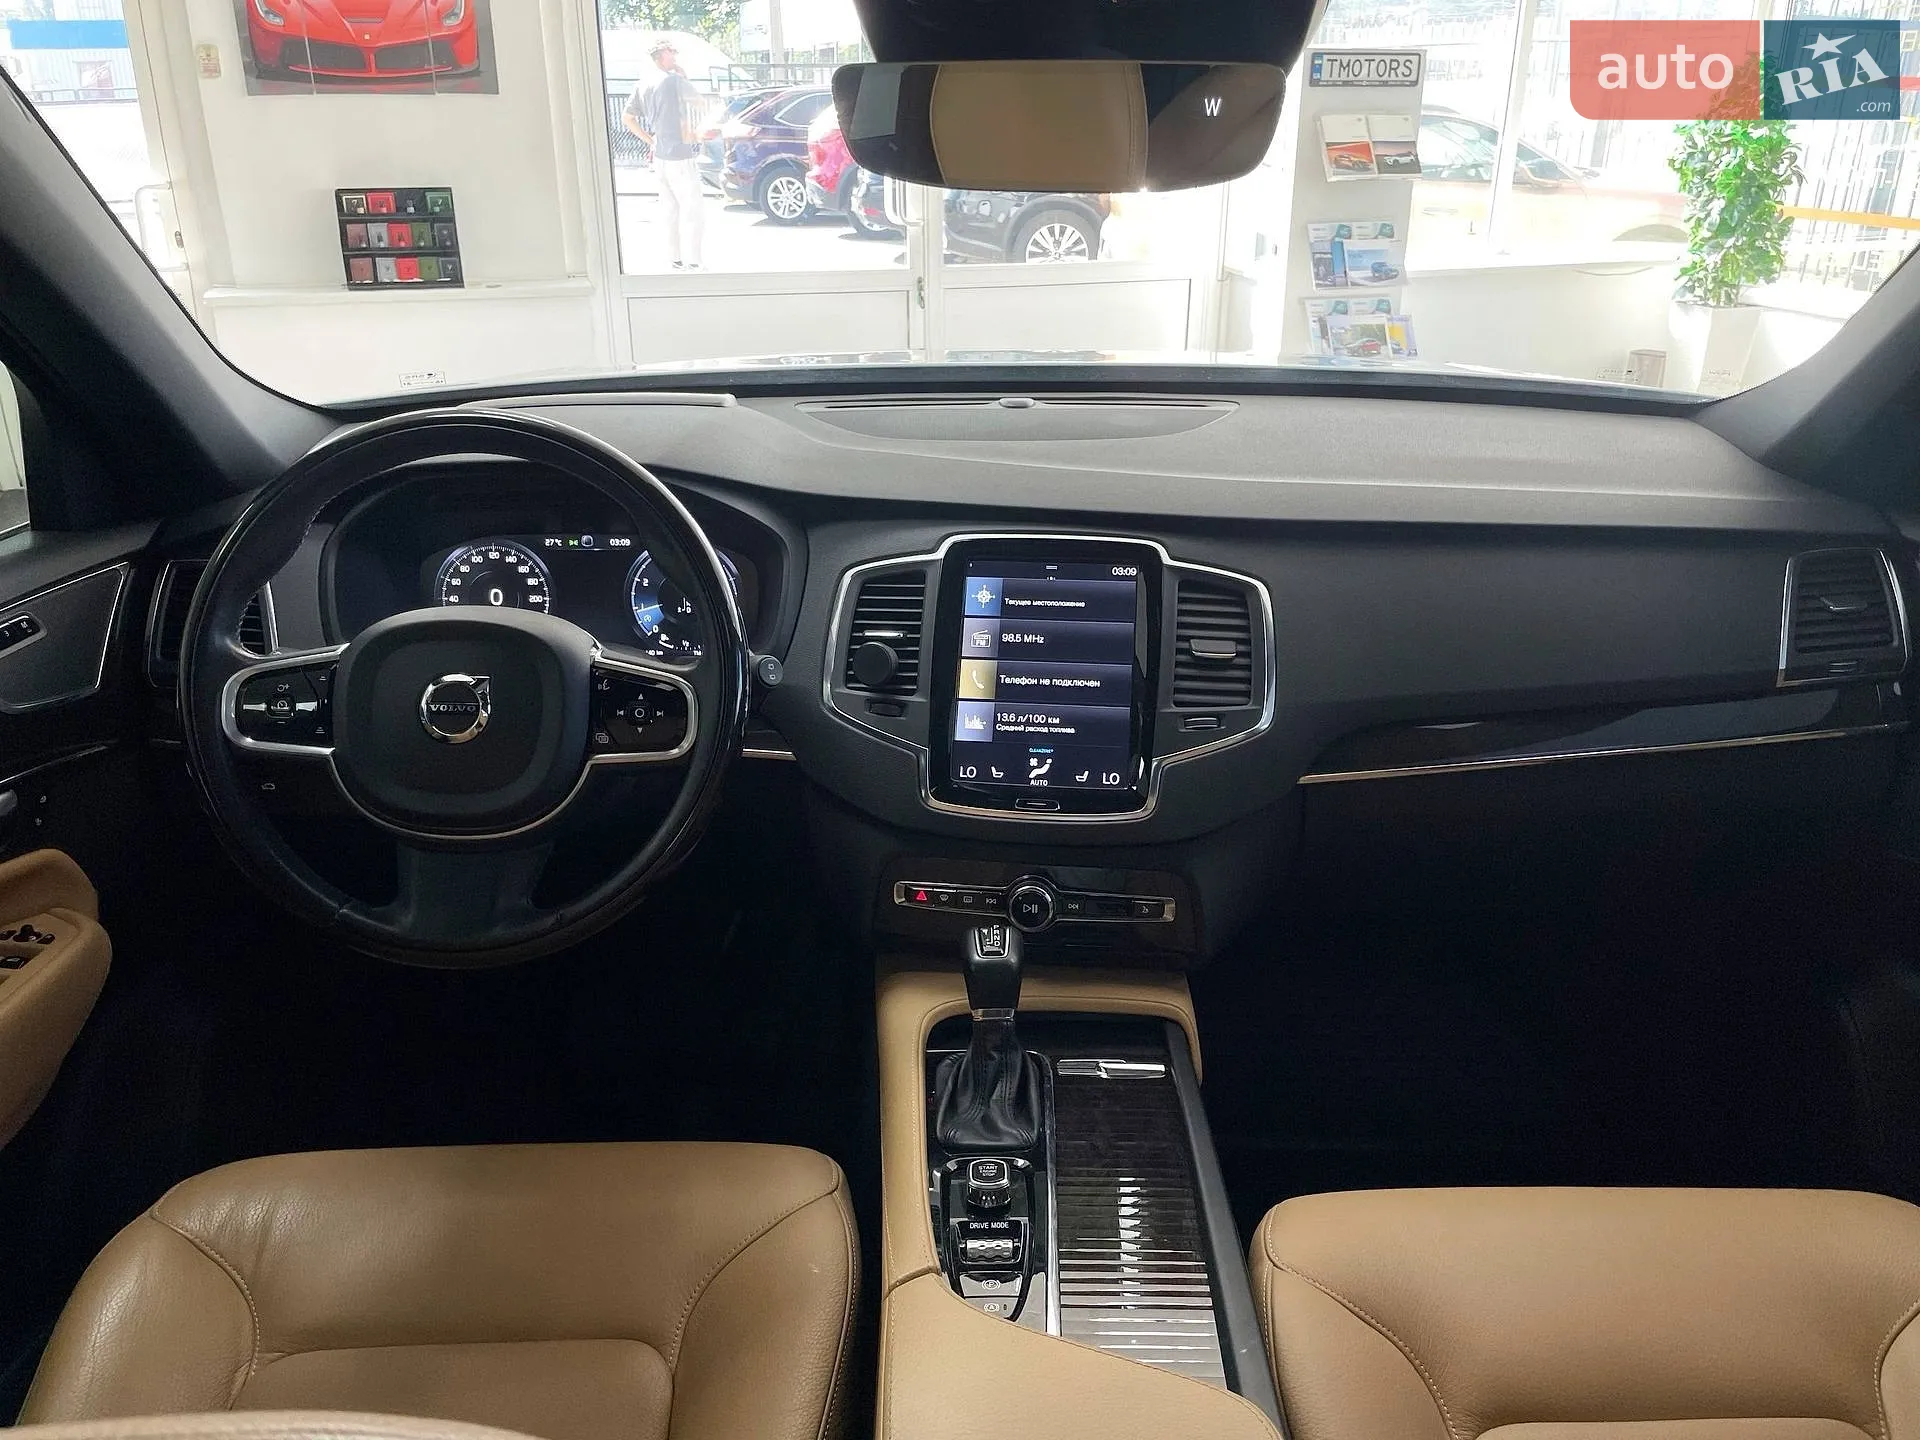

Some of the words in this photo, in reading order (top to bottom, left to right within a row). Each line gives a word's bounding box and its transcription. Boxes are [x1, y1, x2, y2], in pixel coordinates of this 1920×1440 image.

[1326, 58, 1413, 78] TMOTORS
[1205, 97, 1222, 117] W
[609, 538, 631, 547] 03:09
[471, 555, 483, 563] 100
[488, 551, 500, 559] 120
[505, 555, 517, 563] 140
[1111, 566, 1137, 576] 03:09
[448, 595, 459, 603] 40
[489, 588, 504, 606] 0
[528, 595, 543, 603] 200
[1001, 633, 1022, 643] 98.5
[1023, 634, 1045, 644] MHz
[999, 674, 1037, 686] Телефон
[1040, 678, 1050, 686] не
[1052, 679, 1101, 688] подключен
[430, 703, 477, 712] VOLVO
[996, 712, 1016, 722] 13.6
[1017, 713, 1046, 724] л/100
[1047, 716, 1060, 724] км
[959, 766, 977, 778] LO
[1030, 779, 1048, 787] AUTO
[1102, 773, 1120, 785] LO
[969, 1222, 989, 1230] DRIVE
[990, 1222, 1010, 1230] MODE
